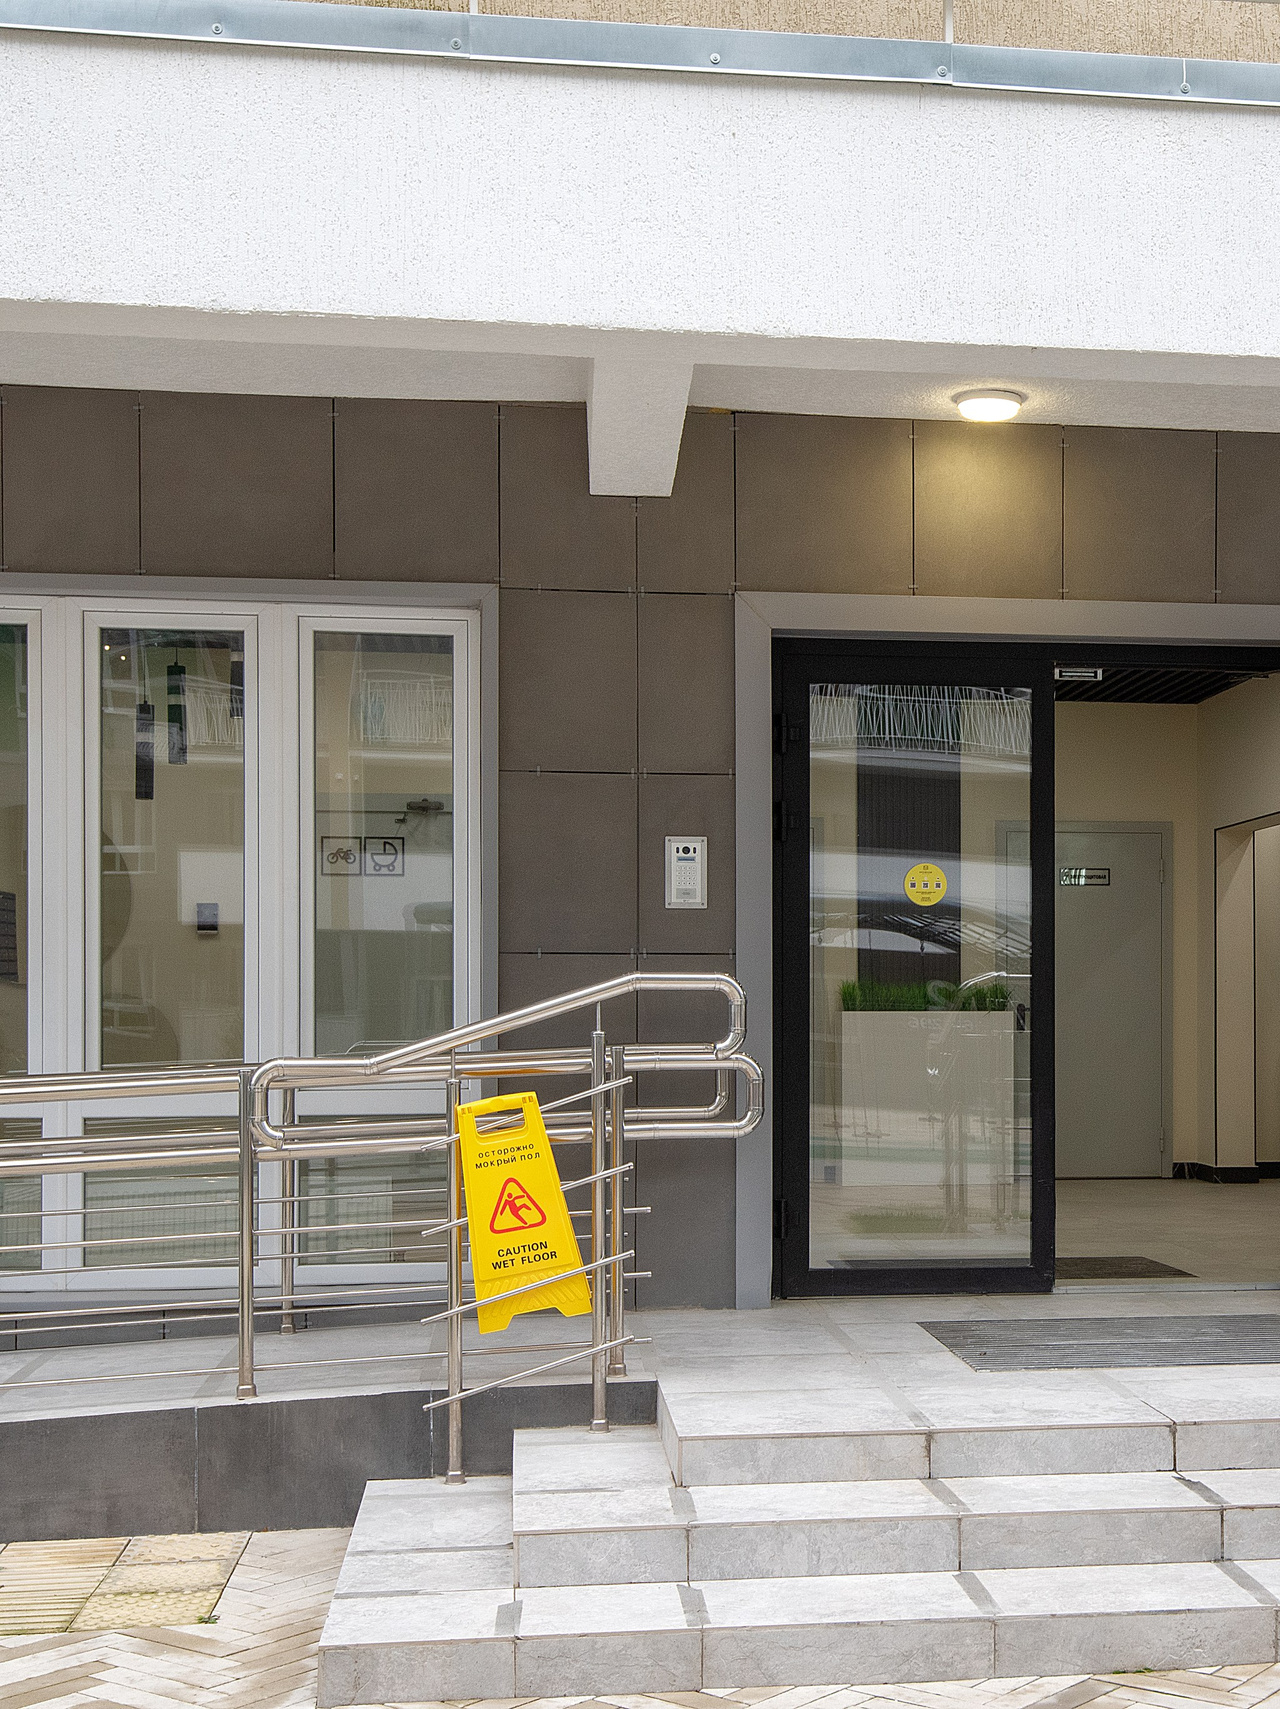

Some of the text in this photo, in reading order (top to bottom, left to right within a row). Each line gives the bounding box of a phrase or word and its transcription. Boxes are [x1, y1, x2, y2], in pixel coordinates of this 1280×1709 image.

[478, 1143, 535, 1159] осторожно
[475, 1151, 541, 1170] мокрый пол
[497, 1240, 548, 1258] CAUTION
[491, 1250, 558, 1271] WET FLOOR
